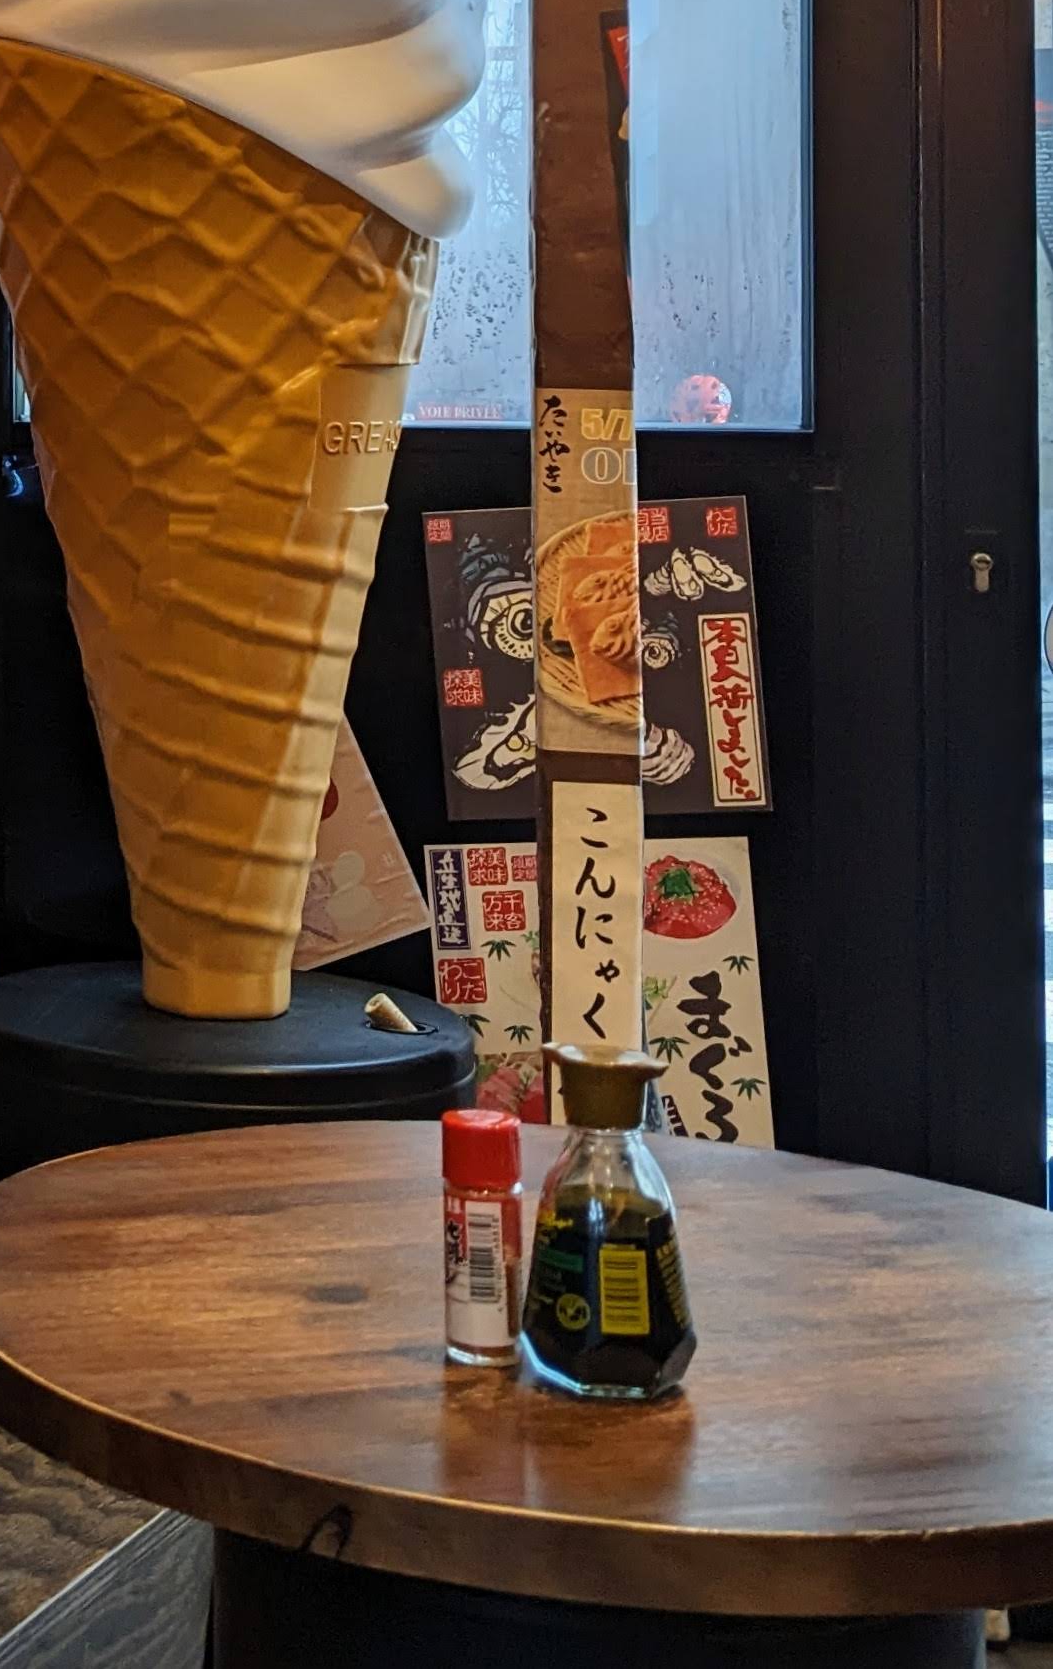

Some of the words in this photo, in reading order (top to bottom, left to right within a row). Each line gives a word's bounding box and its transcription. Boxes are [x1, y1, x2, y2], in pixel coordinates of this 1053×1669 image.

[538, 394, 571, 494] たいやき
[575, 806, 621, 1040] こんにゃく
[676, 971, 753, 1144] まぐろ
